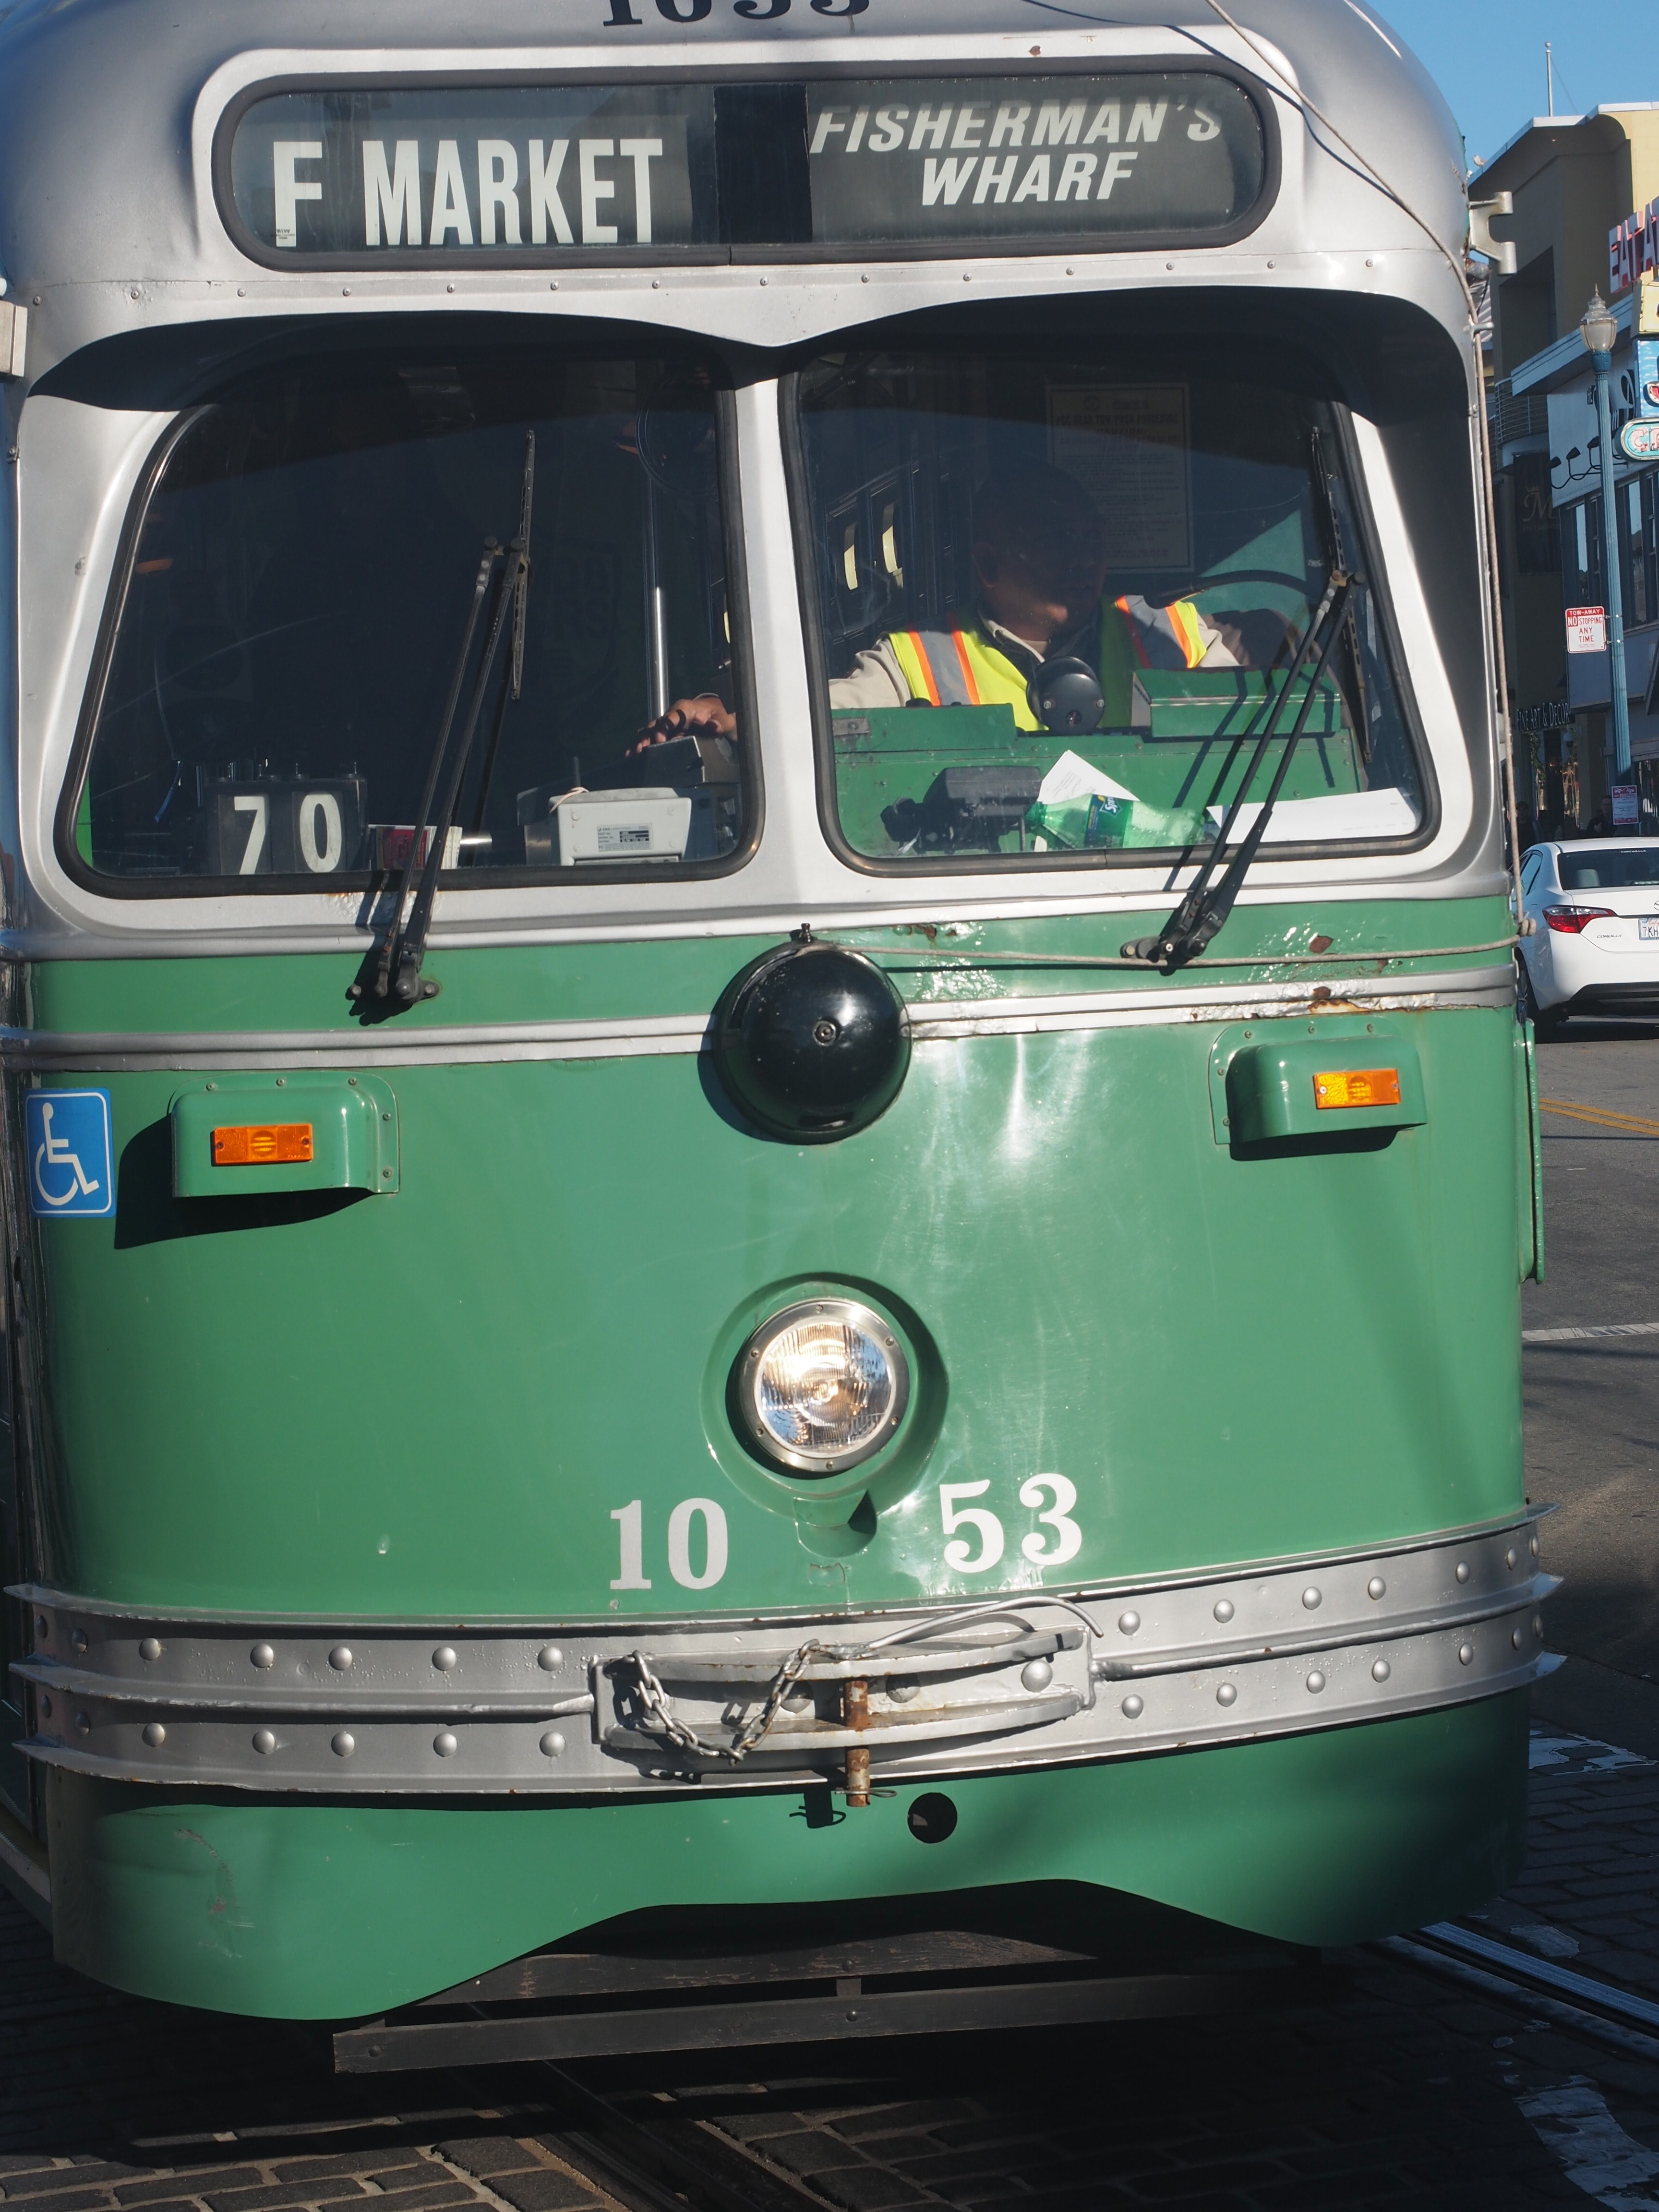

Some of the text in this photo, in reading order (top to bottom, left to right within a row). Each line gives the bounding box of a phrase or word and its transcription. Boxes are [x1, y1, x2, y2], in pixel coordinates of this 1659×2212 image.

[809, 94, 1222, 155] FISHERMAN'S
[273, 139, 662, 247] F MARKET
[920, 151, 1137, 207] WHARF
[1609, 211, 1642, 293] EAT
[1567, 616, 1602, 626] NO STOPPING
[1578, 635, 1595, 643] TIME
[1530, 707, 1540, 730] ART
[1549, 702, 1570, 727] DECOR
[609, 1472, 1083, 1591] 10 53
